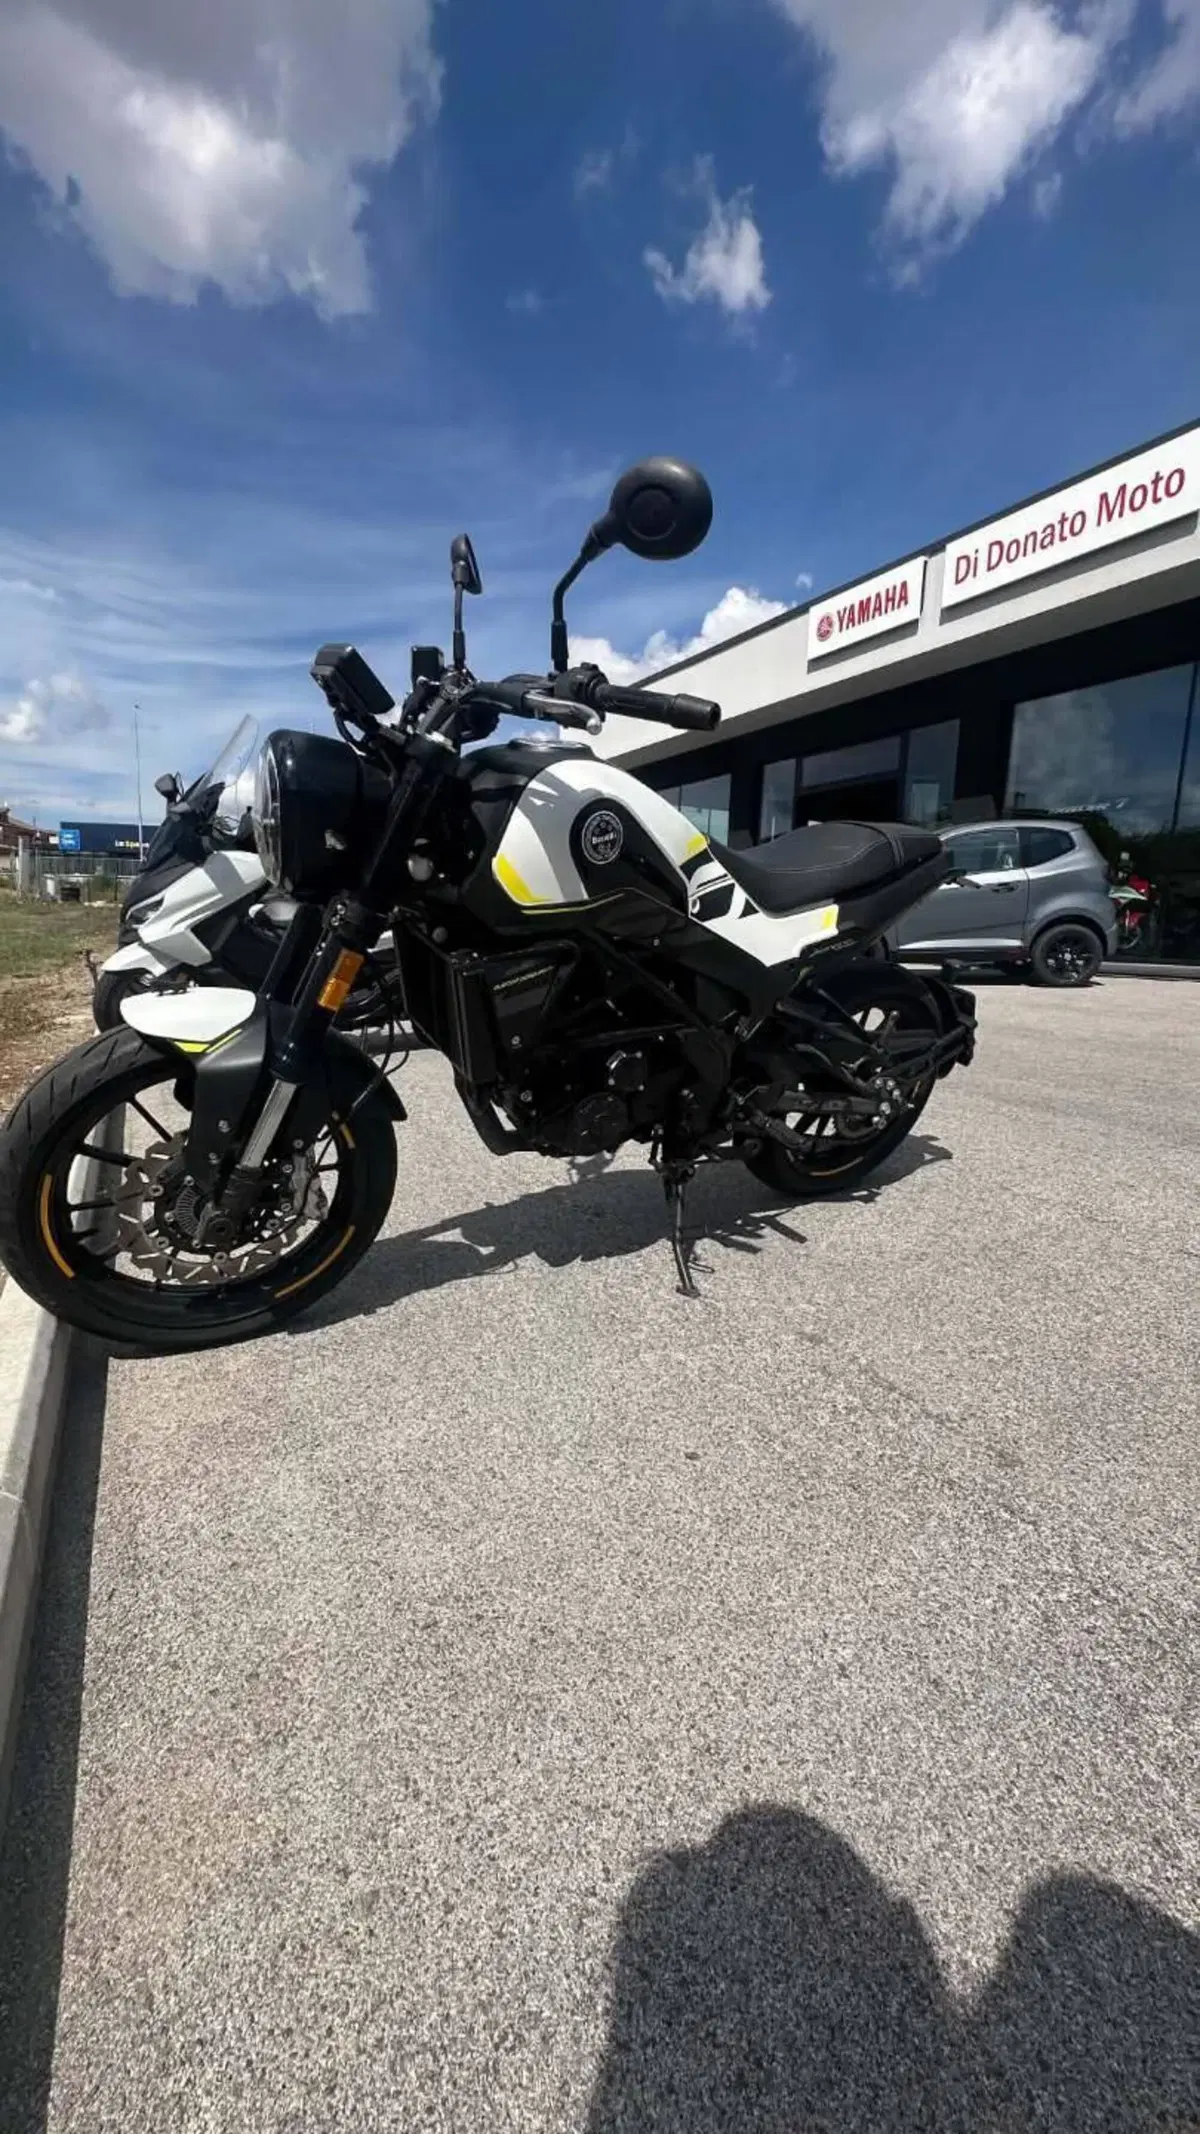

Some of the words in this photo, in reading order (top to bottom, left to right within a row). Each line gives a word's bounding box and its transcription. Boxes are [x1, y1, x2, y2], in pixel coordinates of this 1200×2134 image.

[954, 548, 980, 586] Di
[986, 509, 1088, 573] Donato
[1095, 466, 1187, 528] Moto
[836, 579, 909, 634] YAMAHA
